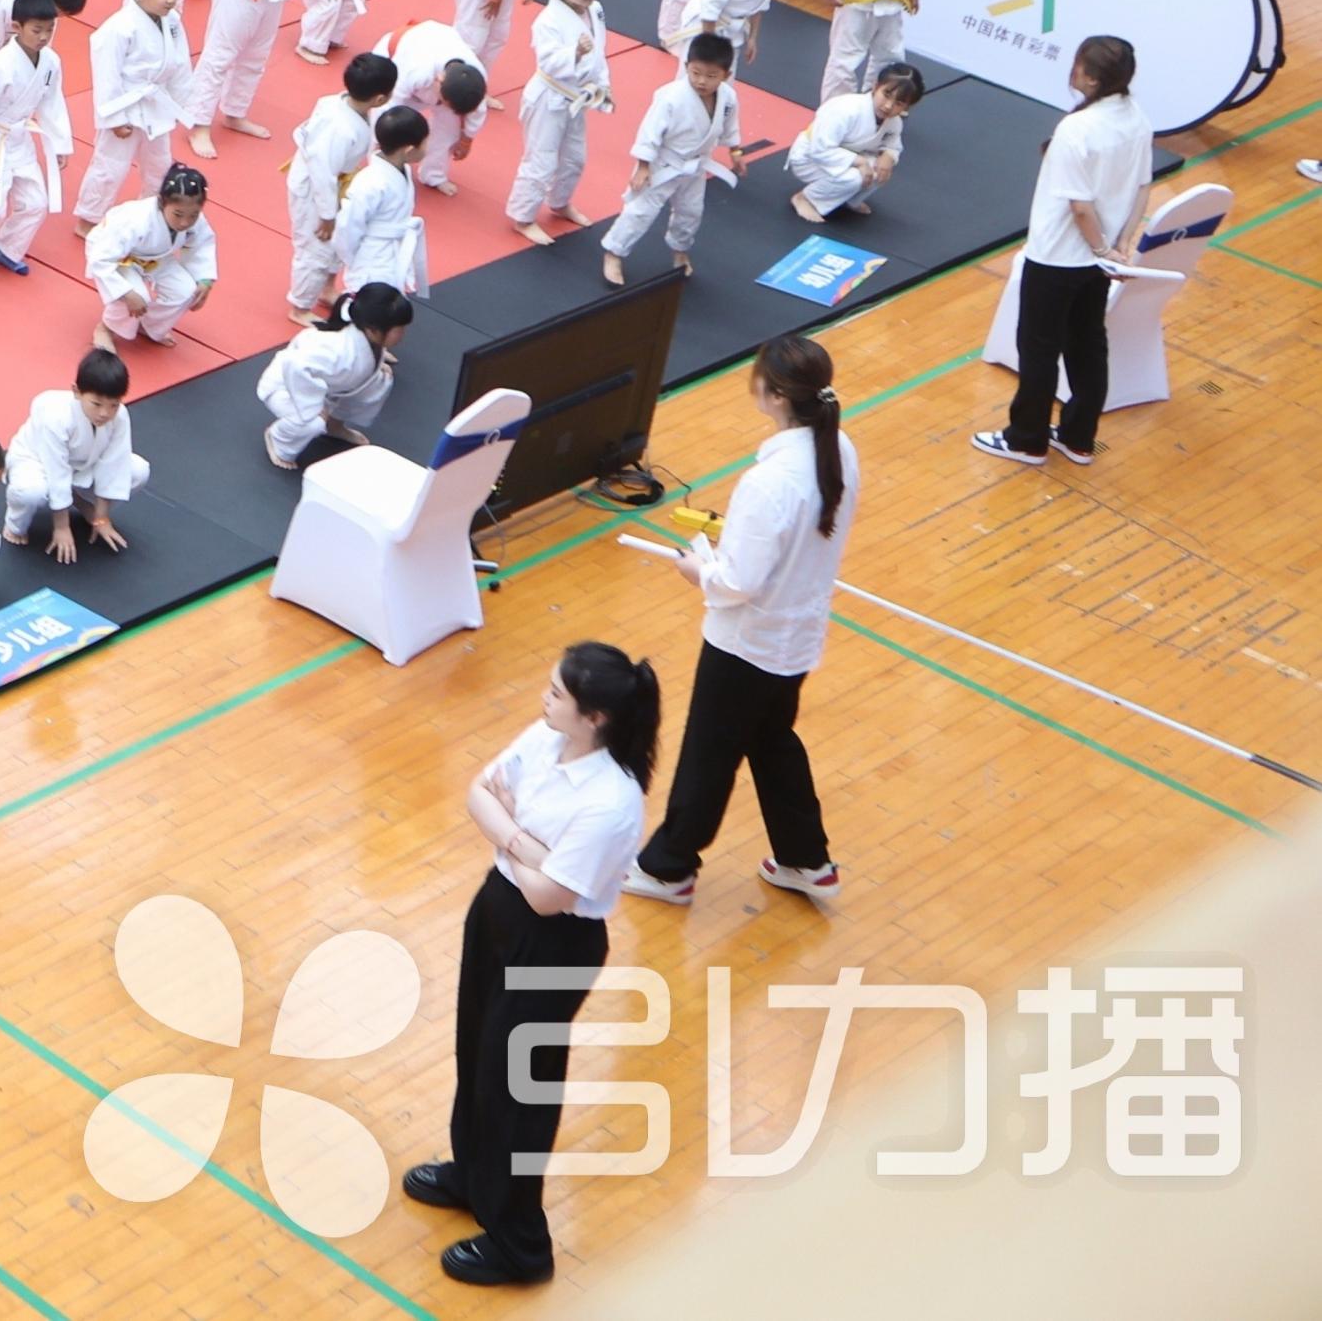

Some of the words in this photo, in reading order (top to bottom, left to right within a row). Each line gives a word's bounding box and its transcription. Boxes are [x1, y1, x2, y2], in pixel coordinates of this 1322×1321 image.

[961, 13, 1062, 63] 中国体育彩票
